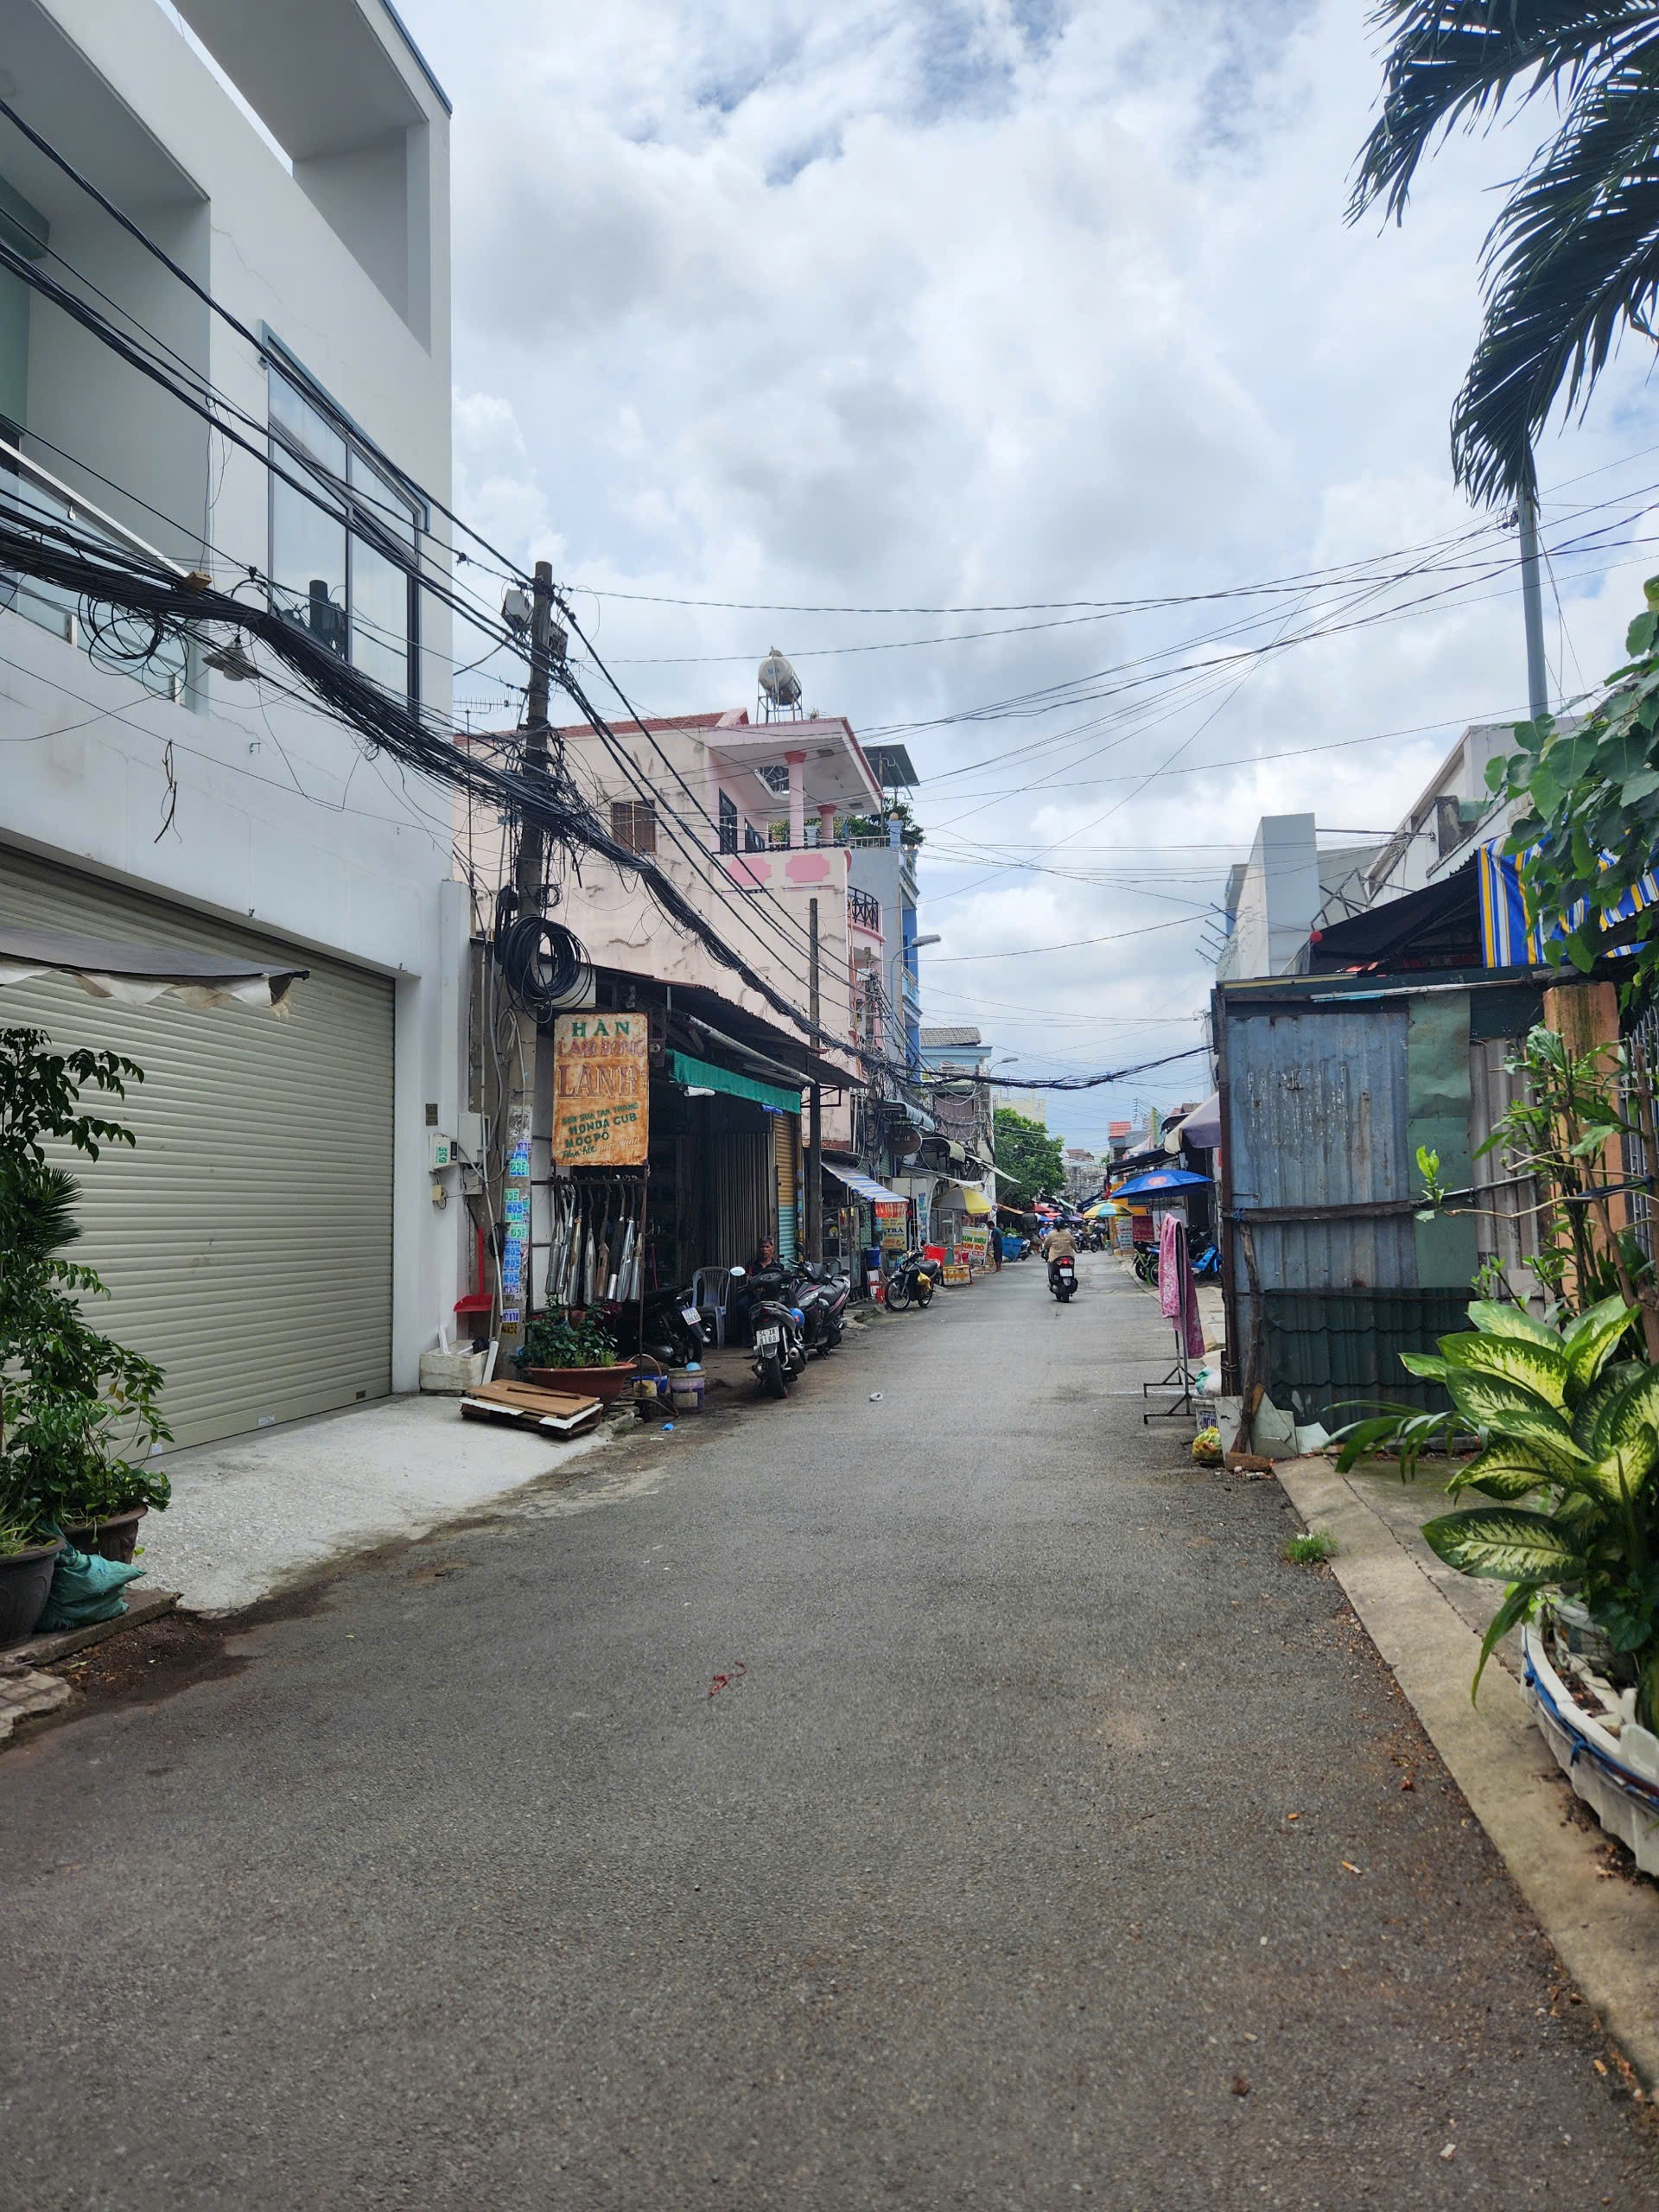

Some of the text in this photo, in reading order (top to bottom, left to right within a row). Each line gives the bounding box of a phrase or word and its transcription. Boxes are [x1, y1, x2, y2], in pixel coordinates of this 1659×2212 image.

[571, 1019, 630, 1037] HÀN
[569, 1113, 637, 1135] HONDA CUB
